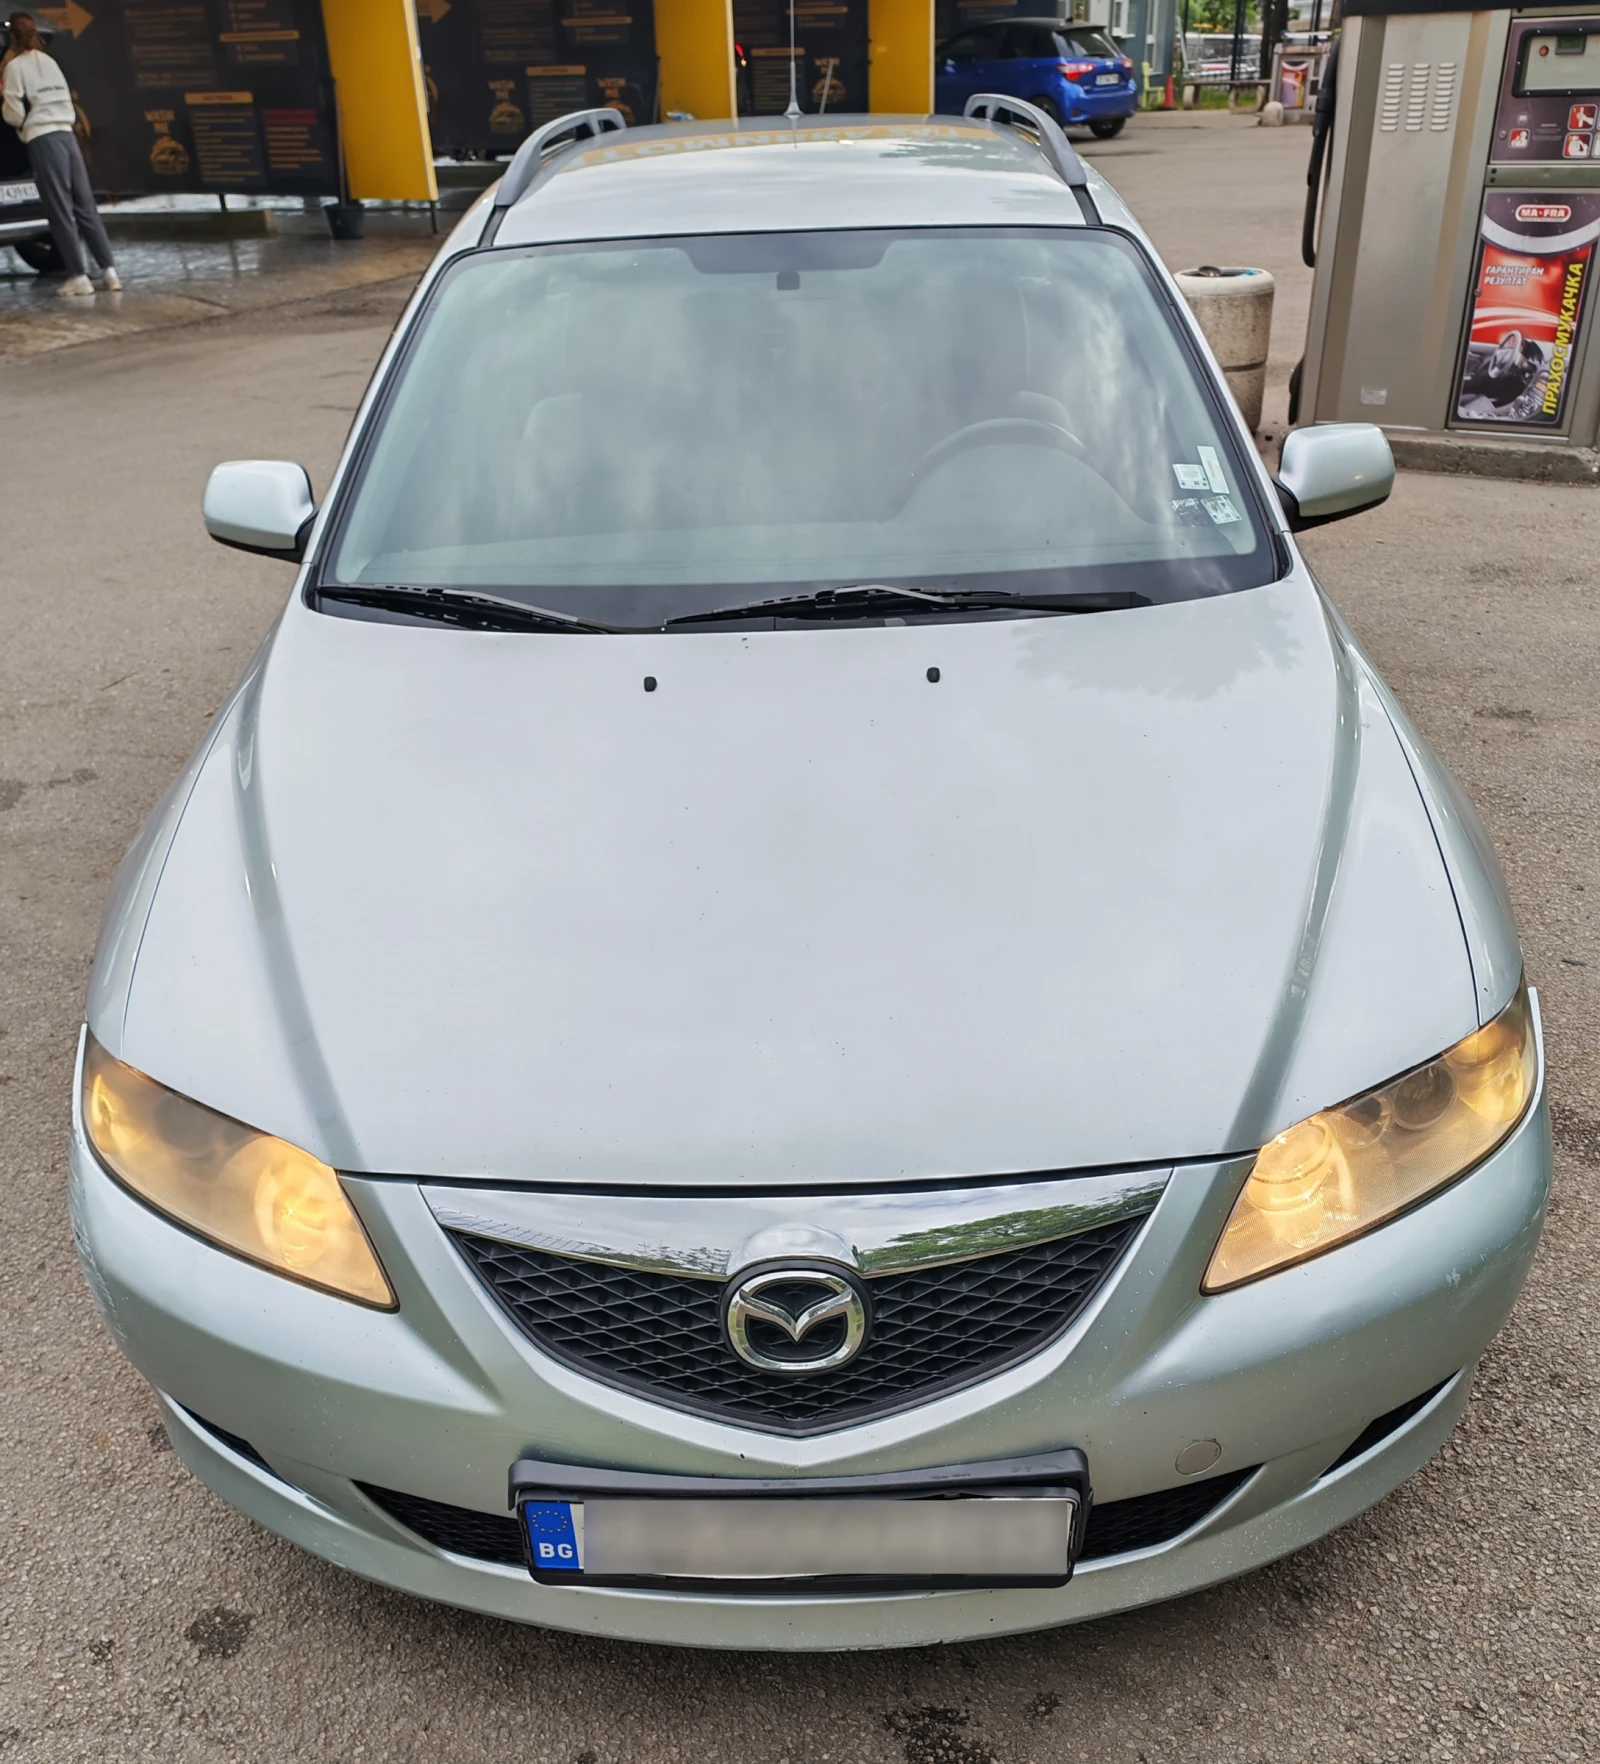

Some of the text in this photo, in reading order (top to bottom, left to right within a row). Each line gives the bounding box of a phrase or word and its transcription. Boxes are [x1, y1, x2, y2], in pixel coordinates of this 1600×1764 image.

[1485, 265, 1545, 276] ГАРАНТИРАН
[1541, 263, 1584, 415] ПРАХОСМУКАЧКА
[539, 1542, 573, 1559] BG
